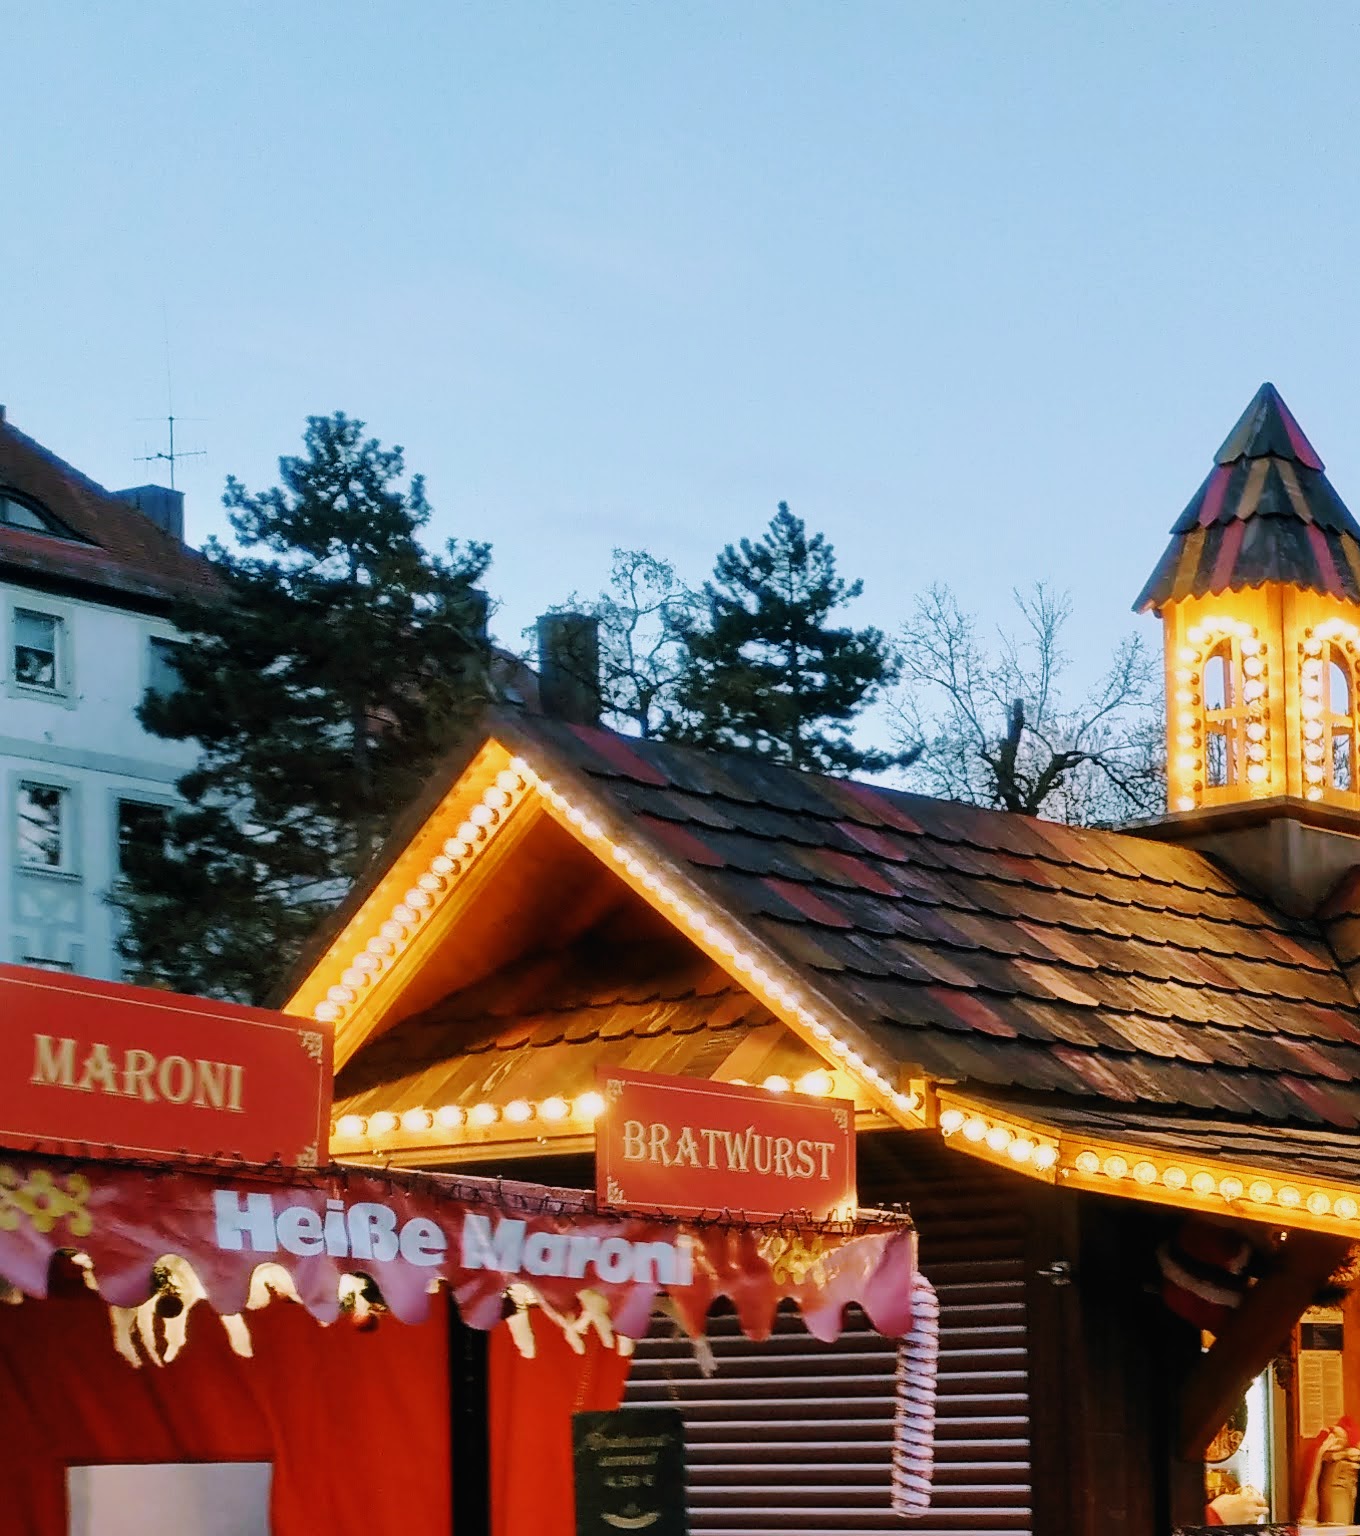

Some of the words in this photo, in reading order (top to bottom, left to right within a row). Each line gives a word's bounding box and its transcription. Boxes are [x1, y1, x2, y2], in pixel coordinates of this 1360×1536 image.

[31, 1033, 246, 1113] MARONI
[622, 1119, 836, 1183] BRATWURST
[213, 1189, 448, 1267] Heiße
[460, 1213, 696, 1287] Maroni
